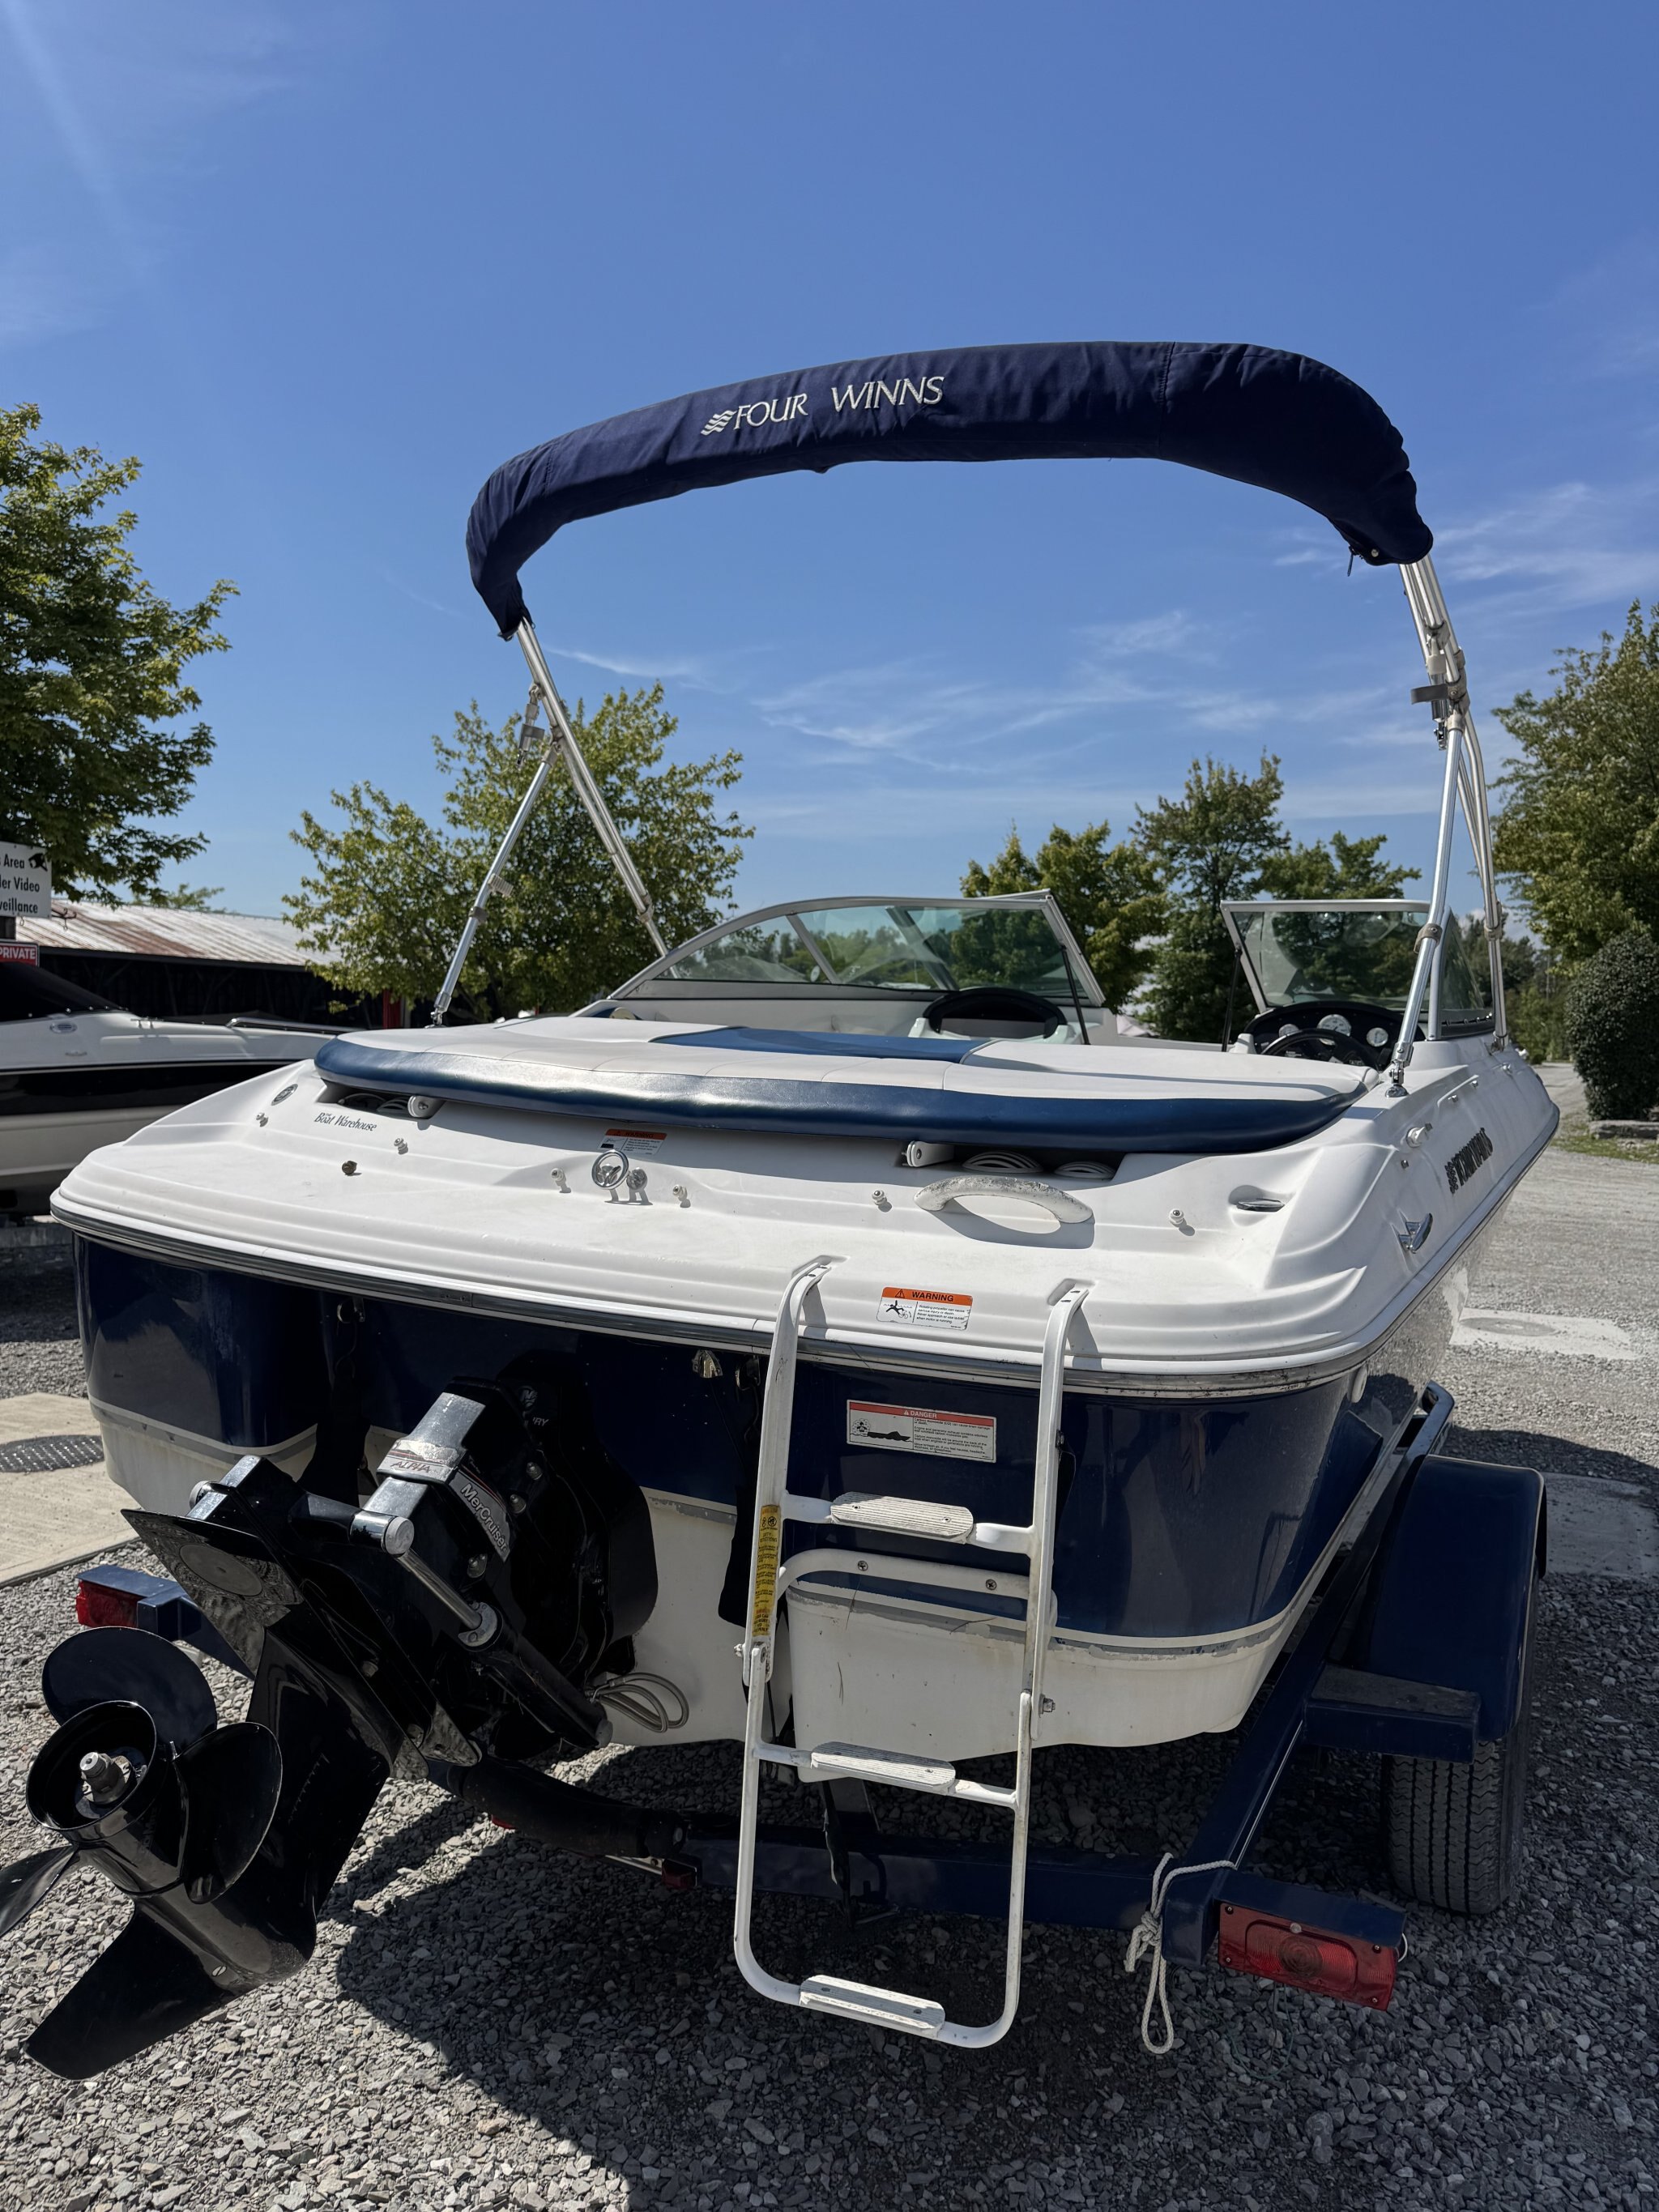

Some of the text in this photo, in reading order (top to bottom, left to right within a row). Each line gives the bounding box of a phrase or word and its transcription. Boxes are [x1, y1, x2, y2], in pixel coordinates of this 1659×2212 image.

[733, 376, 945, 430] FOUR WINNS
[3, 854, 25, 868] Area
[14, 876, 40, 893] Video
[314, 1112, 377, 1131] Boat Warehouse
[912, 1291, 954, 1302] WARNING
[911, 1410, 937, 1419] DANGER
[390, 1461, 431, 1473] ALPHA
[461, 1483, 509, 1553] MerCruiser
